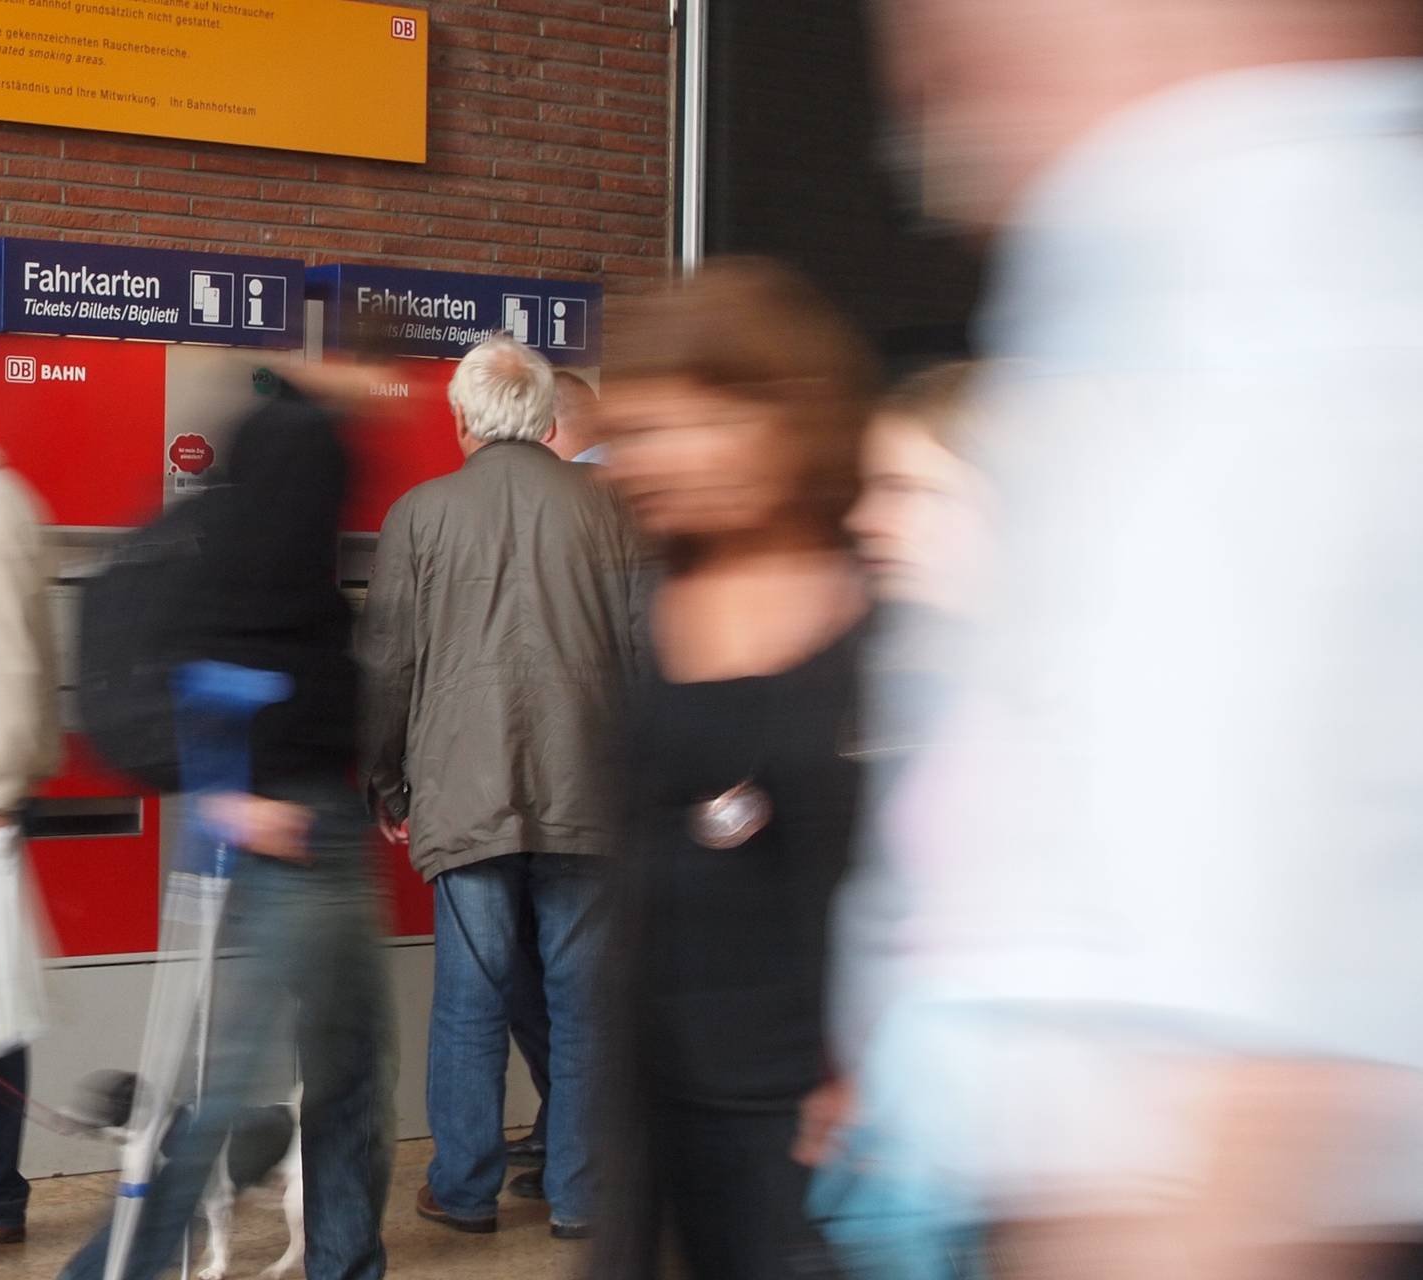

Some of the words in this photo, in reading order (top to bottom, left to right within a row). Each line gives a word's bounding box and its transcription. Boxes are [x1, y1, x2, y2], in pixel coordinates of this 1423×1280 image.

[75, 5, 144, 20] grundsätzlich
[147, 12, 172, 23] nicht
[212, 4, 274, 20] Nichtraucher
[394, 20, 413, 37] DB
[6, 29, 98, 48] gekennzeichneten
[102, 38, 190, 58] Raucherbereiche.
[28, 48, 72, 64] smoking
[75, 54, 106, 66] areas.
[54, 84, 74, 96] und
[77, 87, 97, 99] Ihre
[100, 89, 160, 106] Mitwirkung.
[170, 96, 184, 108] Ihr
[187, 99, 256, 116] Bahnhofsteam
[24, 262, 160, 299] Fahrkarten
[357, 287, 476, 321] Fahrkarten
[10, 361, 31, 378] DB
[41, 364, 86, 382] BAHN
